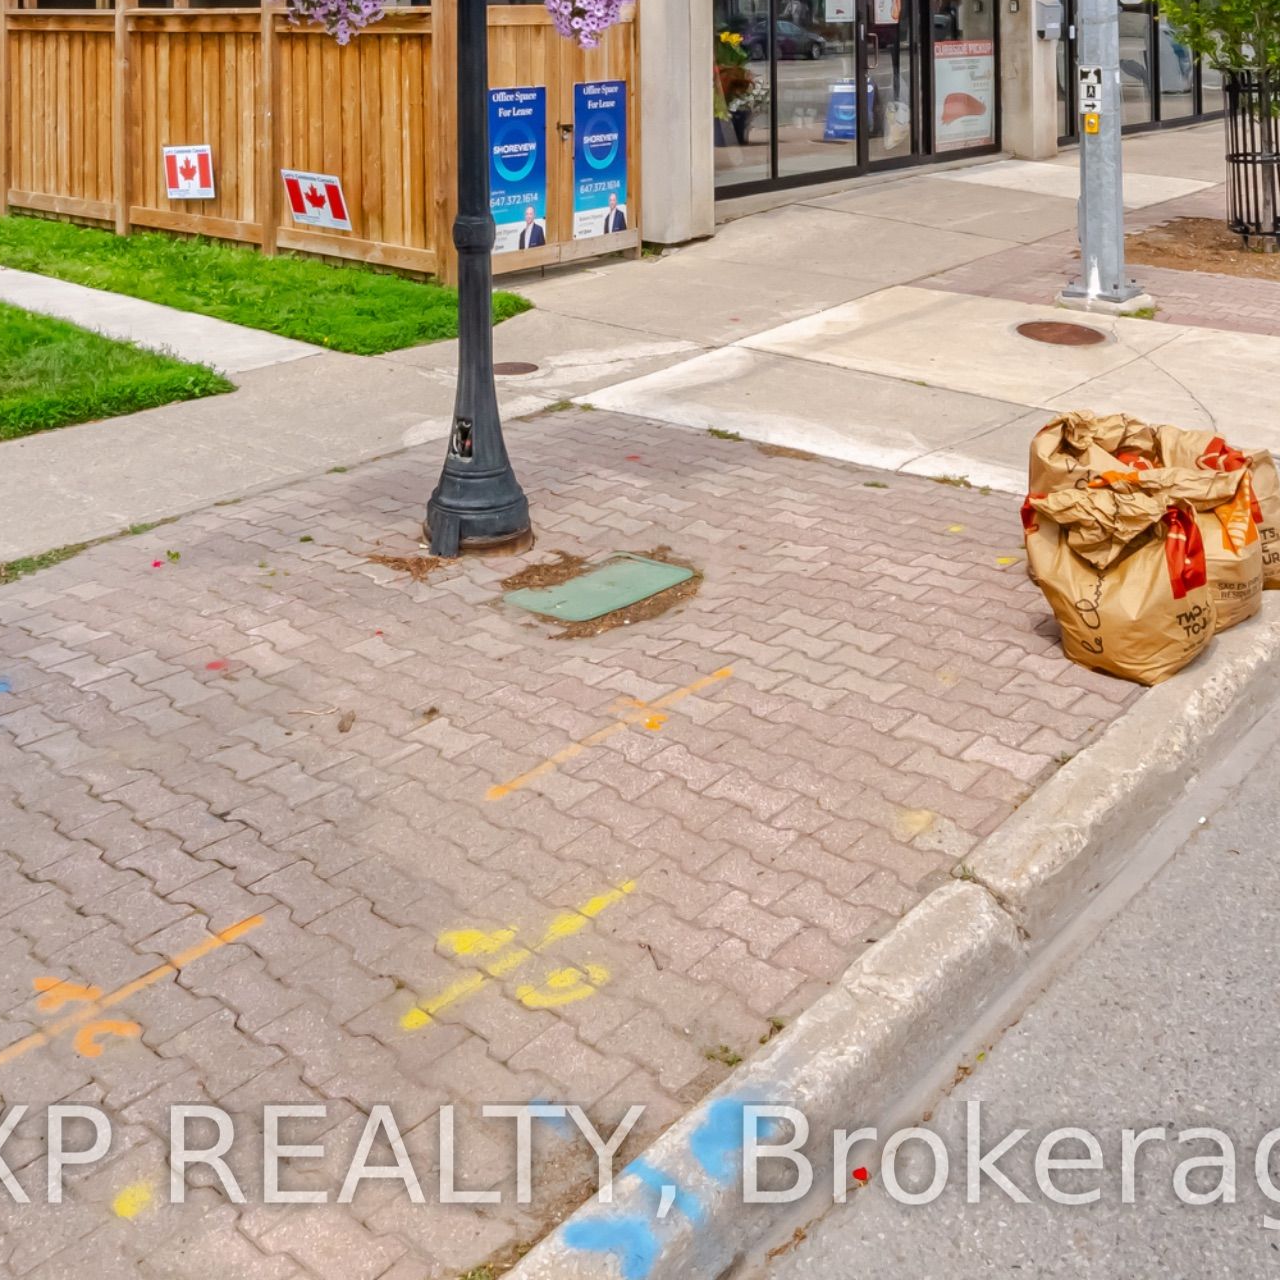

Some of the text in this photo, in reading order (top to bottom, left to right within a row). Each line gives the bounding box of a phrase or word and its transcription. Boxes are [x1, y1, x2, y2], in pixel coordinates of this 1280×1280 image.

[492, 91, 537, 103] Office Space
[587, 100, 597, 109] For
[498, 106, 533, 117] For Lease
[583, 132, 618, 144] SHOREVIEW
[493, 142, 537, 154] SHOREVIEW
[1260, 527, 1280, 540] TS,
[1262, 551, 1280, 566] UR
